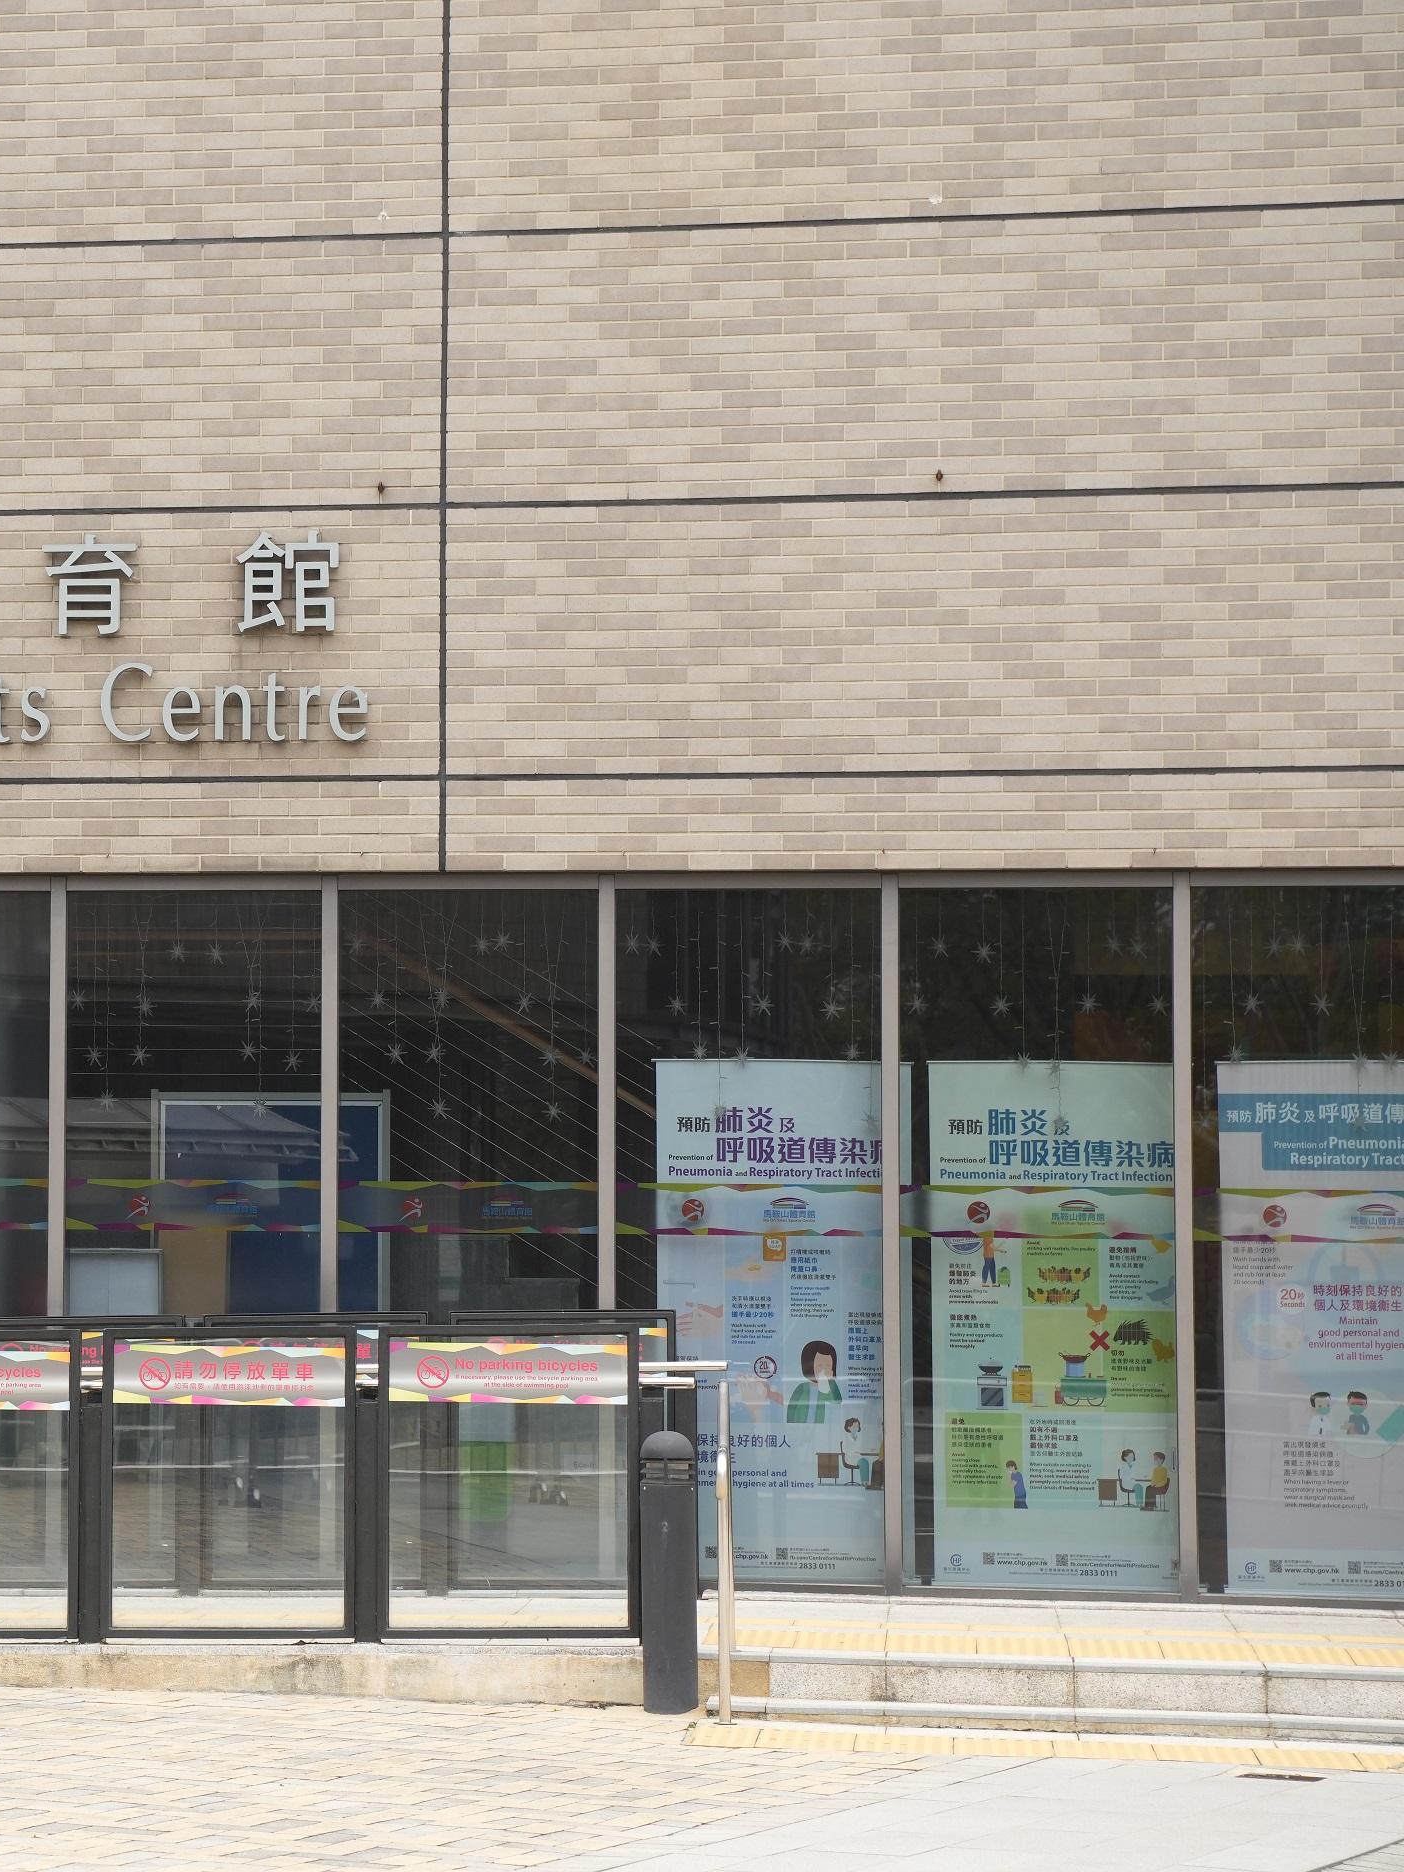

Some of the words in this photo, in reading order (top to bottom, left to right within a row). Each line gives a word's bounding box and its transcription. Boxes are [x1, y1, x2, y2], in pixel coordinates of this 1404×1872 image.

[100, 662, 369, 744] Centre
[1274, 1141, 1317, 1149] Prevention
[1318, 1140, 1327, 1148] of
[989, 1139, 1174, 1168] 呼吸道傳染病
[1290, 1153, 1369, 1168] Respiratory
[1371, 1153, 1404, 1165] Tract
[668, 1166, 733, 1177] Pneumonia
[749, 1167, 812, 1179] Respiratory
[815, 1168, 842, 1178] Tract
[845, 1168, 882, 1178] Infecti
[940, 1169, 1006, 1180] Pneumonia
[1023, 1170, 1088, 1183] Respiratory
[1091, 1171, 1118, 1181] Tract
[1121, 1171, 1173, 1182] Infection
[1313, 1285, 1402, 1297] 時刻保持良好的
[1339, 1317, 1378, 1325] Maintain
[1318, 1329, 1340, 1338] good
[1343, 1329, 1381, 1338] personal
[1383, 1329, 1400, 1337] and
[1308, 1340, 1373, 1349] environmental
[1375, 1341, 1404, 1350] hygien
[1359, 1353, 1383, 1361] times
[174, 1361, 315, 1382] 請勿停放單車
[455, 1359, 473, 1370] No
[479, 1359, 532, 1373] parking
[538, 1360, 597, 1374] bicycles
[732, 1470, 769, 1478] personal
[733, 1481, 768, 1489] hygiene
[734, 1552, 769, 1560] .chp.gov.hk
